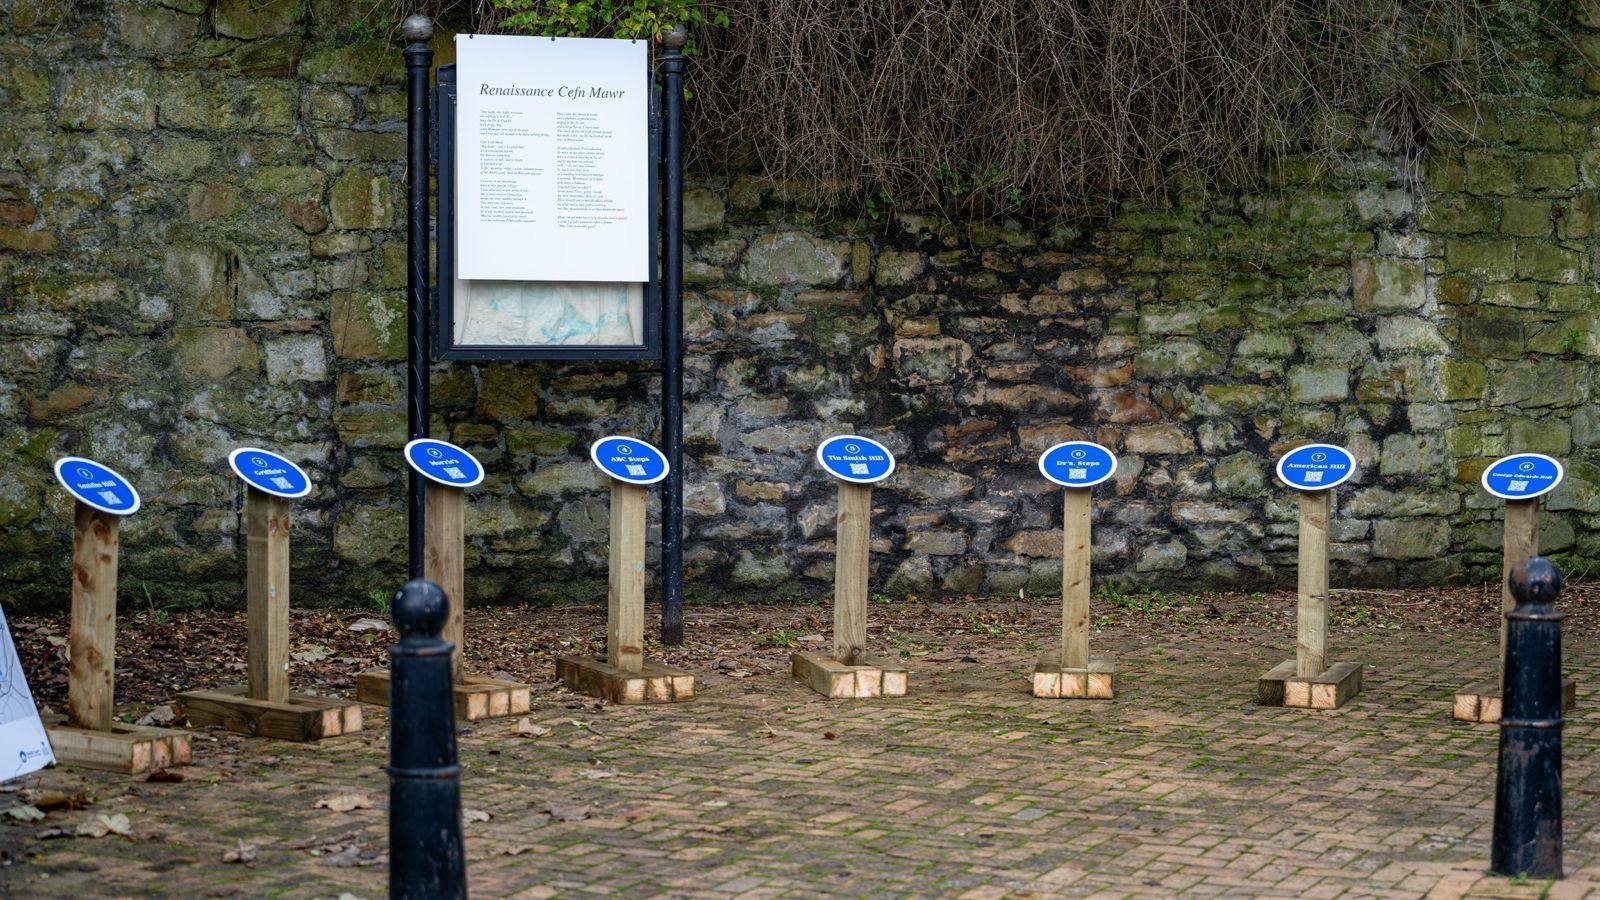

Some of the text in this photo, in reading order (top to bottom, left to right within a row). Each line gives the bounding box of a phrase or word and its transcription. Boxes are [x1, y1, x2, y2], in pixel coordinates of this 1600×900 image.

[479, 83, 625, 100] Renaissance Cefn Mawr
[101, 480, 117, 488] Hill
